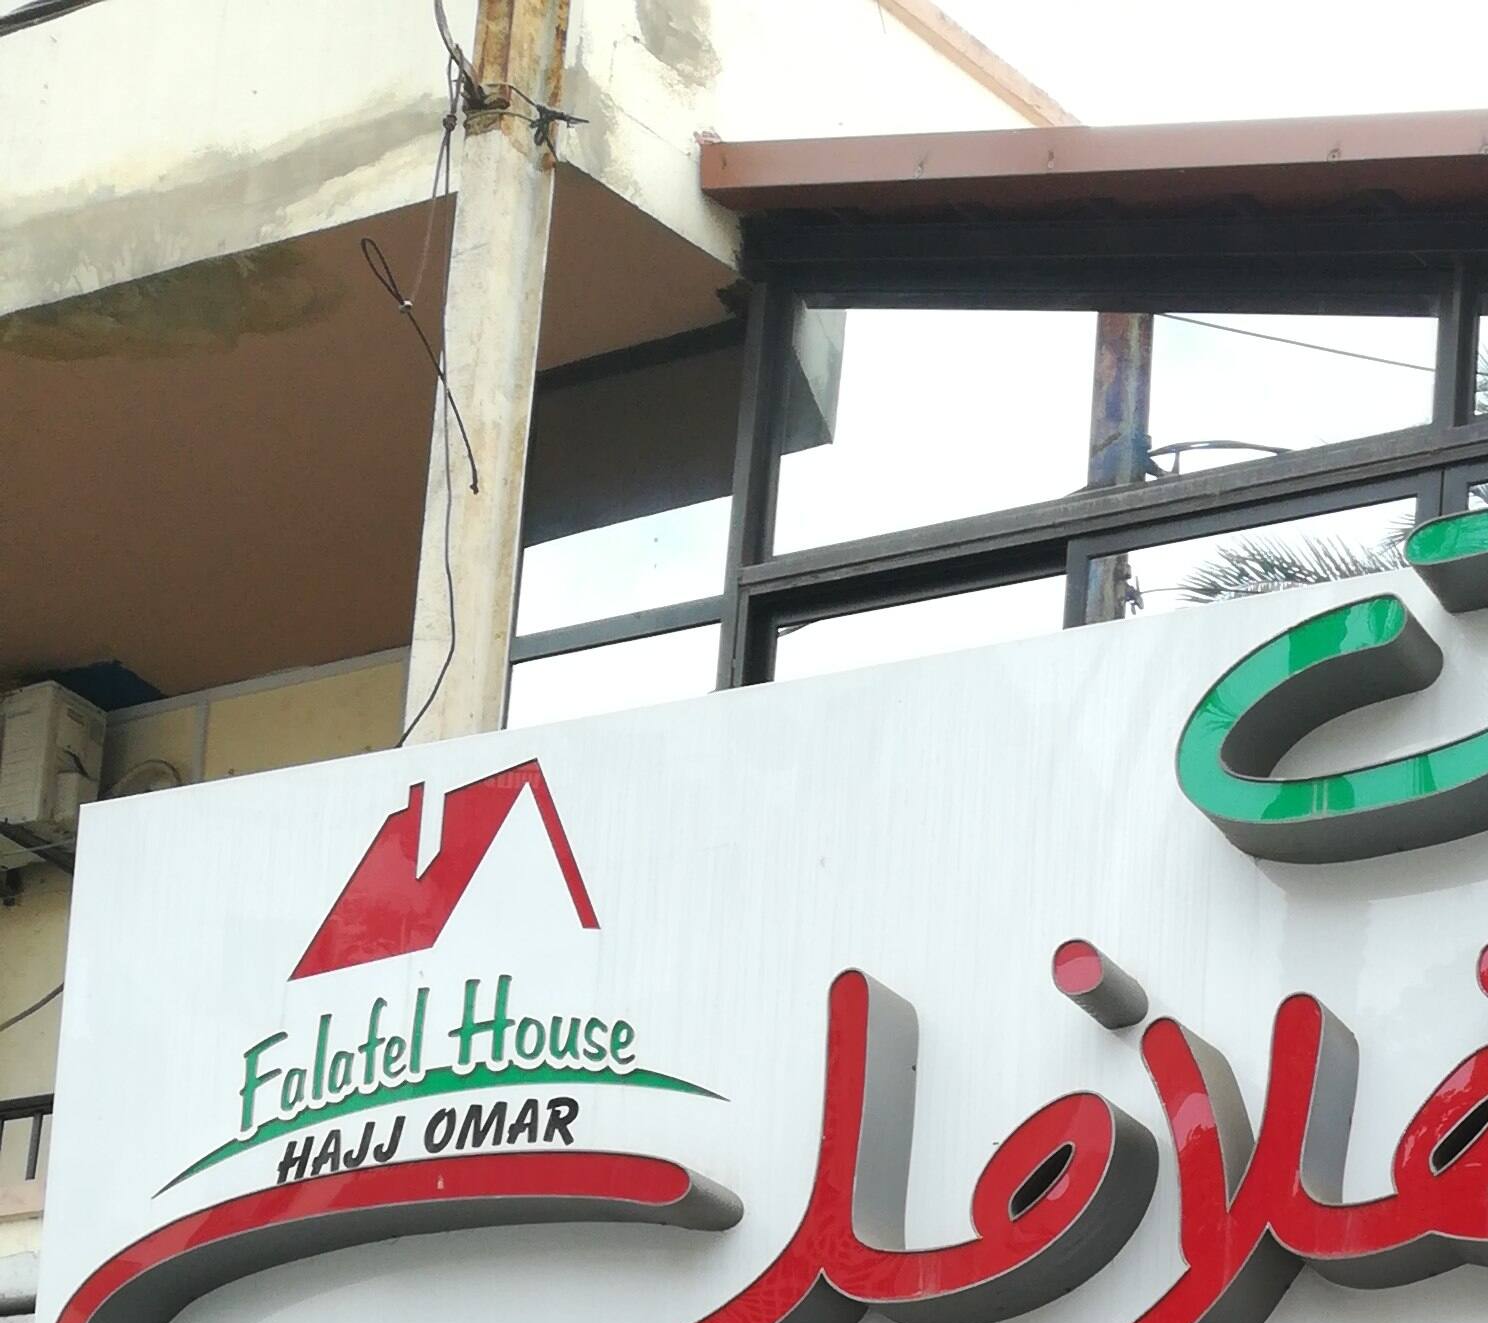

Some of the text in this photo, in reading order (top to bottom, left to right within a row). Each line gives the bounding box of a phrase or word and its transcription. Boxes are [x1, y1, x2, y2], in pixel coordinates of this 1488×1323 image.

[239, 974, 637, 1133] Falafel House
[277, 1096, 580, 1184] HAJJ OMAR
